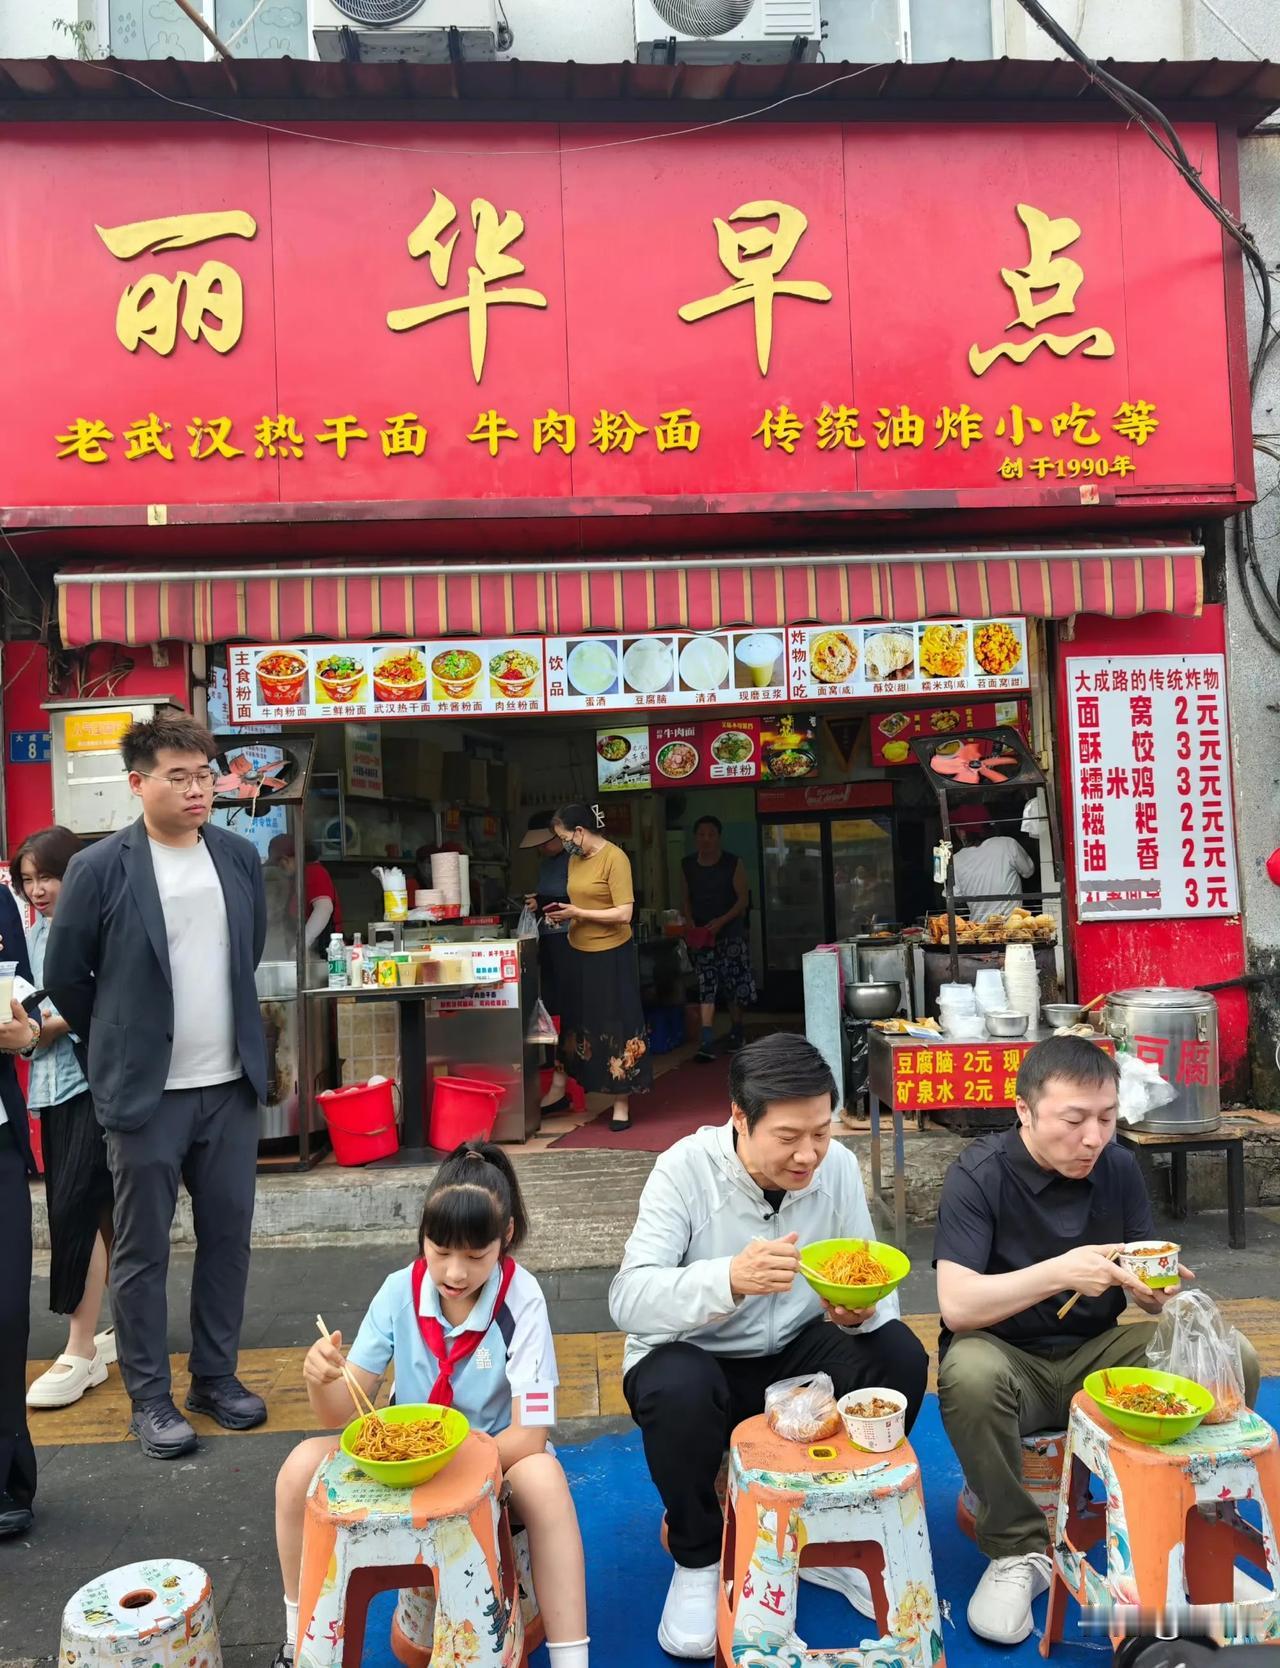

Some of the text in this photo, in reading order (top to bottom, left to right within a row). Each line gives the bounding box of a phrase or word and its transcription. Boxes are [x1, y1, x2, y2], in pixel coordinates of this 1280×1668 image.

[95, 188, 1115, 384] 丽华早点
[55, 400, 1159, 463] 老武汉热干面 牛肉粉面 传统油炸小吃等
[549, 656, 564, 696] 饮品
[791, 630, 808, 699] 炸物小吃
[235, 651, 251, 718] 主食粉面
[1075, 668, 1219, 692] 大成路的传统炸物
[374, 701, 431, 714] 武汉热干面
[438, 700, 483, 713] 炸酱粉面
[495, 699, 539, 712] 肉丝粉面
[585, 696, 606, 707] 蛋酒
[635, 694, 667, 705] 豆腐脑
[695, 692, 717, 703] 清酒
[739, 689, 782, 701] 现磨豆浆
[262, 705, 307, 718] 牛肉粉面
[321, 703, 367, 716] 三鲜粉面
[1076, 694, 1219, 728] 面窝 2元
[28, 743, 36, 758] 8
[1078, 730, 1221, 763] 酥饺 3元
[714, 764, 752, 776] 三鲜粉
[1080, 765, 1221, 799] 糯米鸡 3元
[1181, 801, 1224, 831] 2元
[1083, 837, 1226, 872] 油香 2元
[1185, 876, 1228, 908] 3元
[897, 1050, 953, 1075] 豆腐脑
[963, 1050, 992, 1071] 2元
[896, 1079, 953, 1105] 矿泉水
[965, 1079, 993, 1101] 2元
